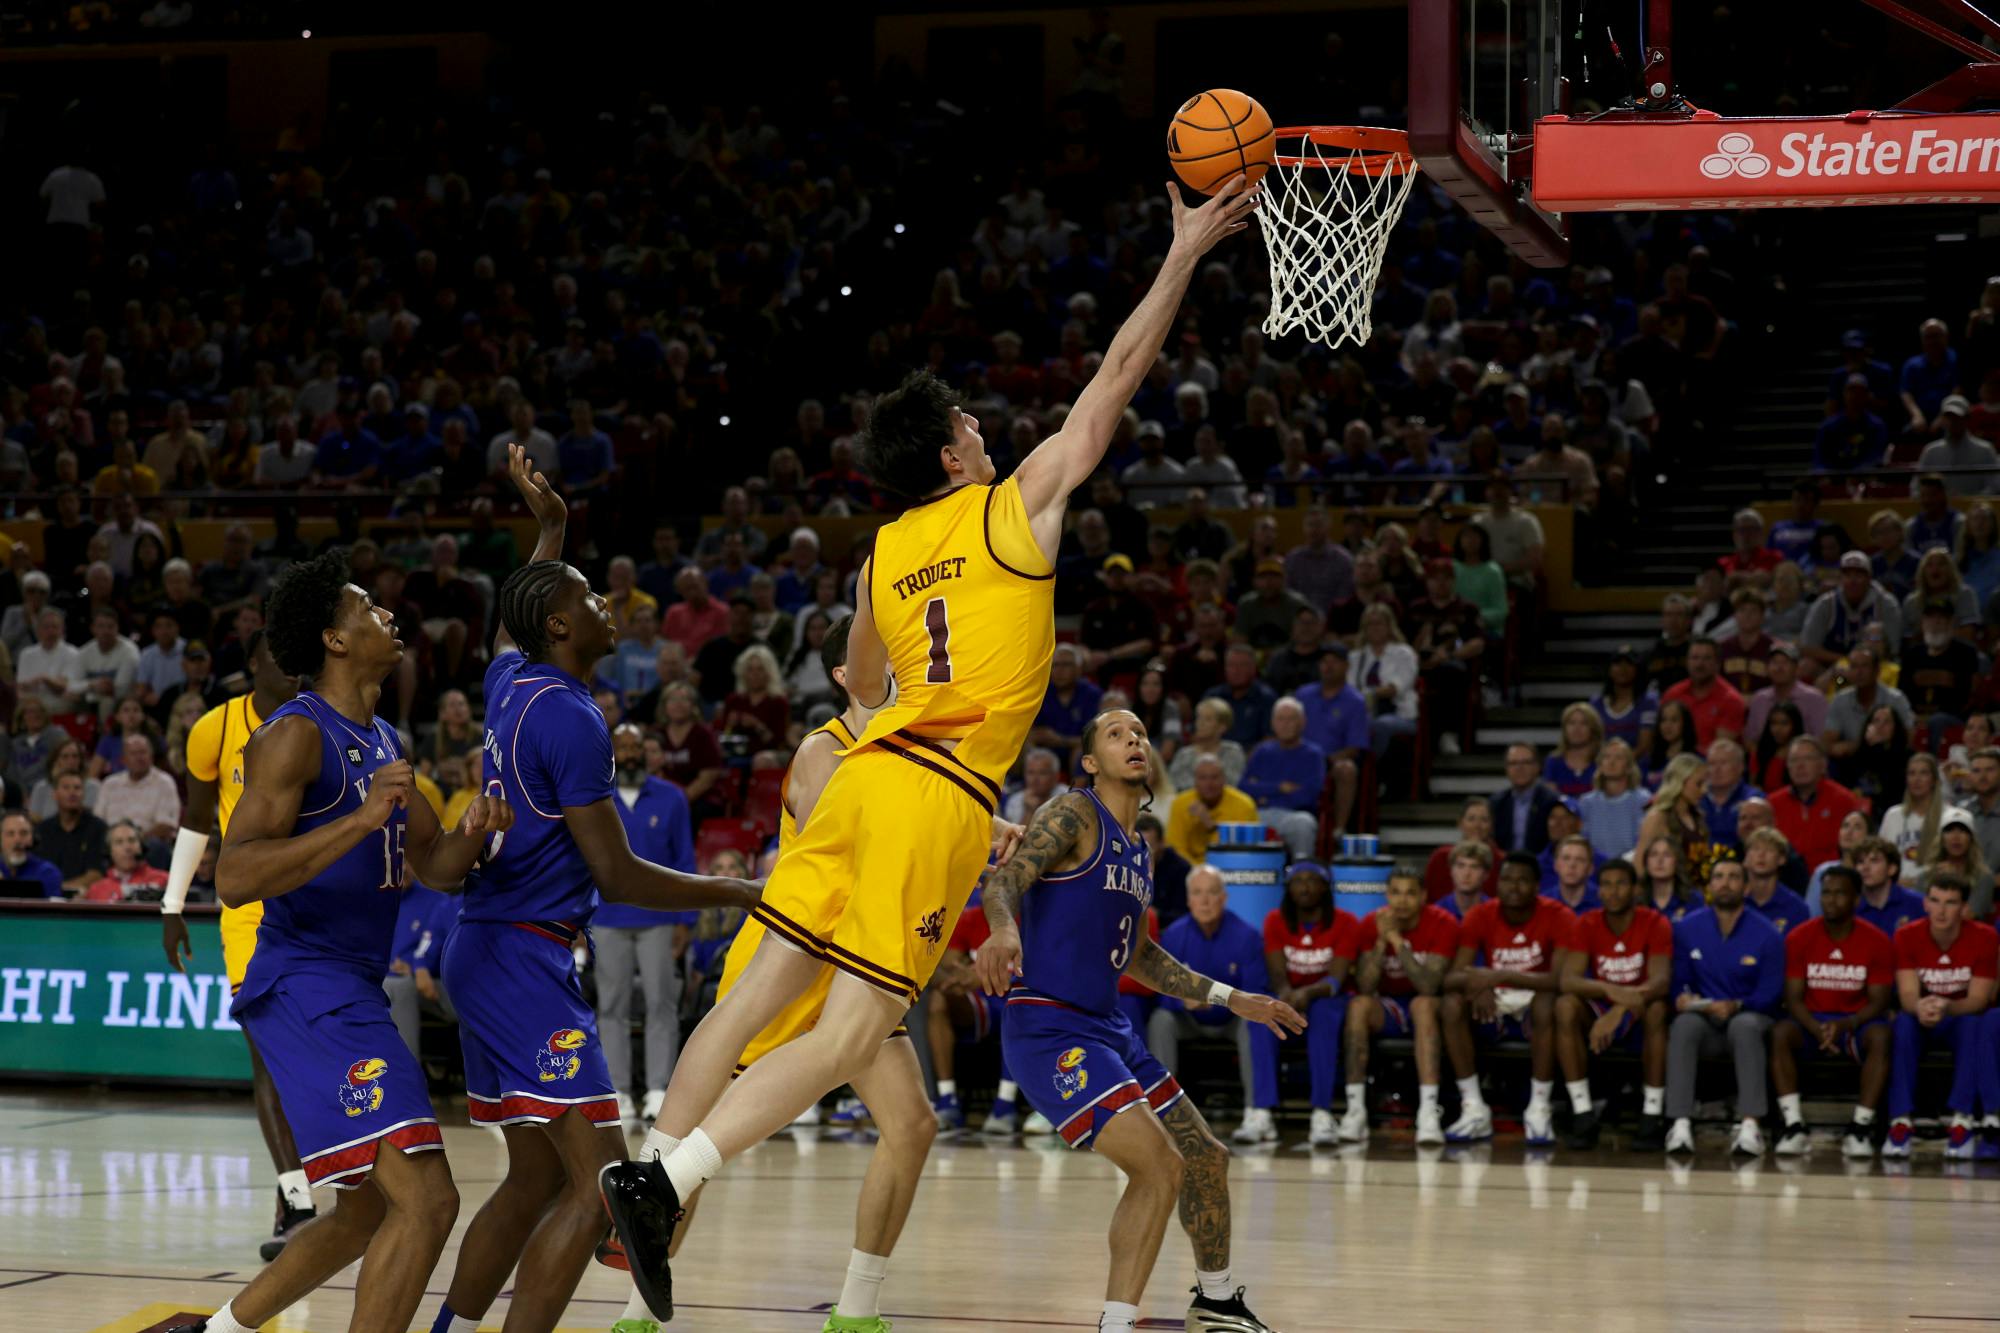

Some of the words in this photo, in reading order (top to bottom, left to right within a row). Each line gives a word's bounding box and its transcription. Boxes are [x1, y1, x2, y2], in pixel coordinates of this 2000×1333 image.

[1777, 131, 1902, 177] State
[892, 556, 967, 600] TROUET
[925, 597, 951, 684] 1
[378, 823, 406, 889] 15
[1103, 863, 1151, 912] KANSA
[1110, 915, 1132, 969] 3
[0, 967, 87, 1025] HT
[552, 1056, 565, 1067] KU
[352, 1088, 367, 1101] KU
